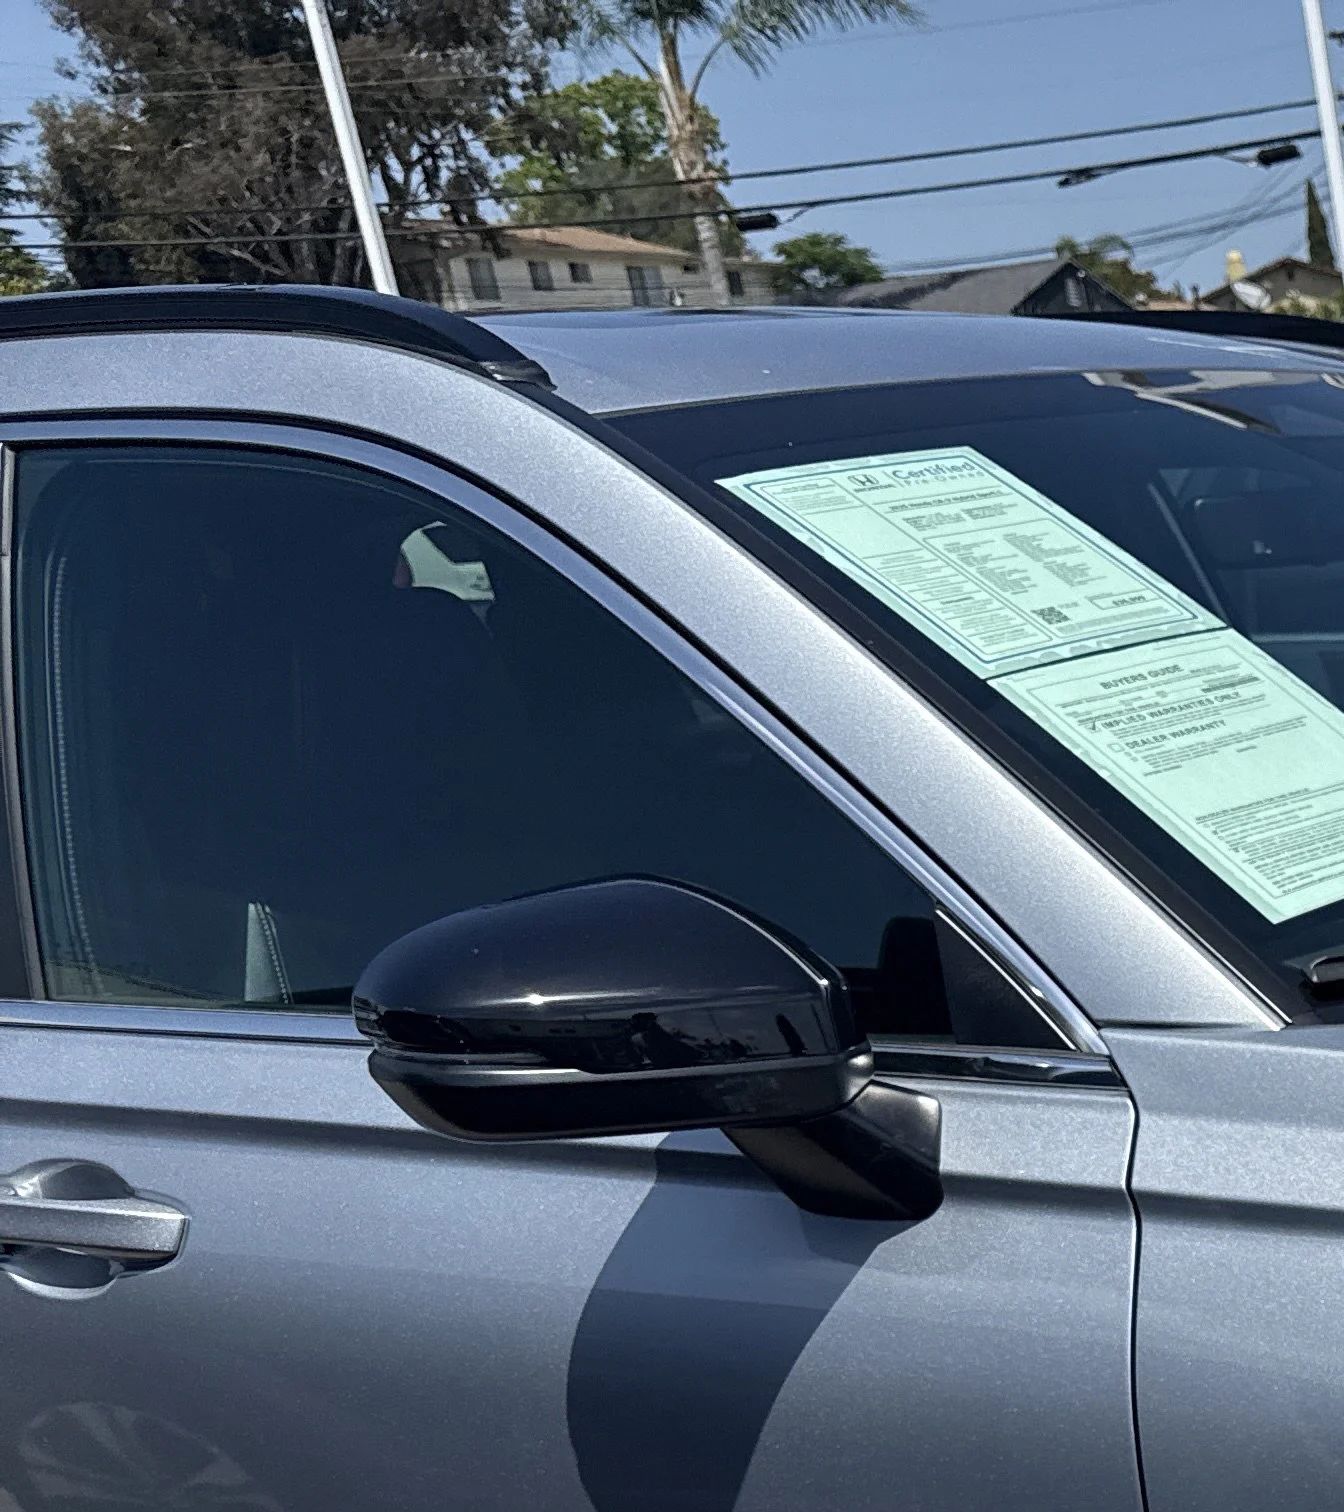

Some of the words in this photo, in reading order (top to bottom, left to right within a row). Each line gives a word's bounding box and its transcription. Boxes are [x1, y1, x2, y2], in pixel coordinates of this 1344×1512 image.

[892, 462, 976, 480] Certified
[1100, 673, 1148, 690] BUYERS
[1149, 664, 1185, 681] GUIDE
[1100, 710, 1147, 730] IMPLIED
[1149, 697, 1214, 719] WARRANTIES
[1214, 690, 1242, 705] ONLY
[1125, 732, 1170, 750] DEALER
[1170, 718, 1228, 740] WARRANTY
